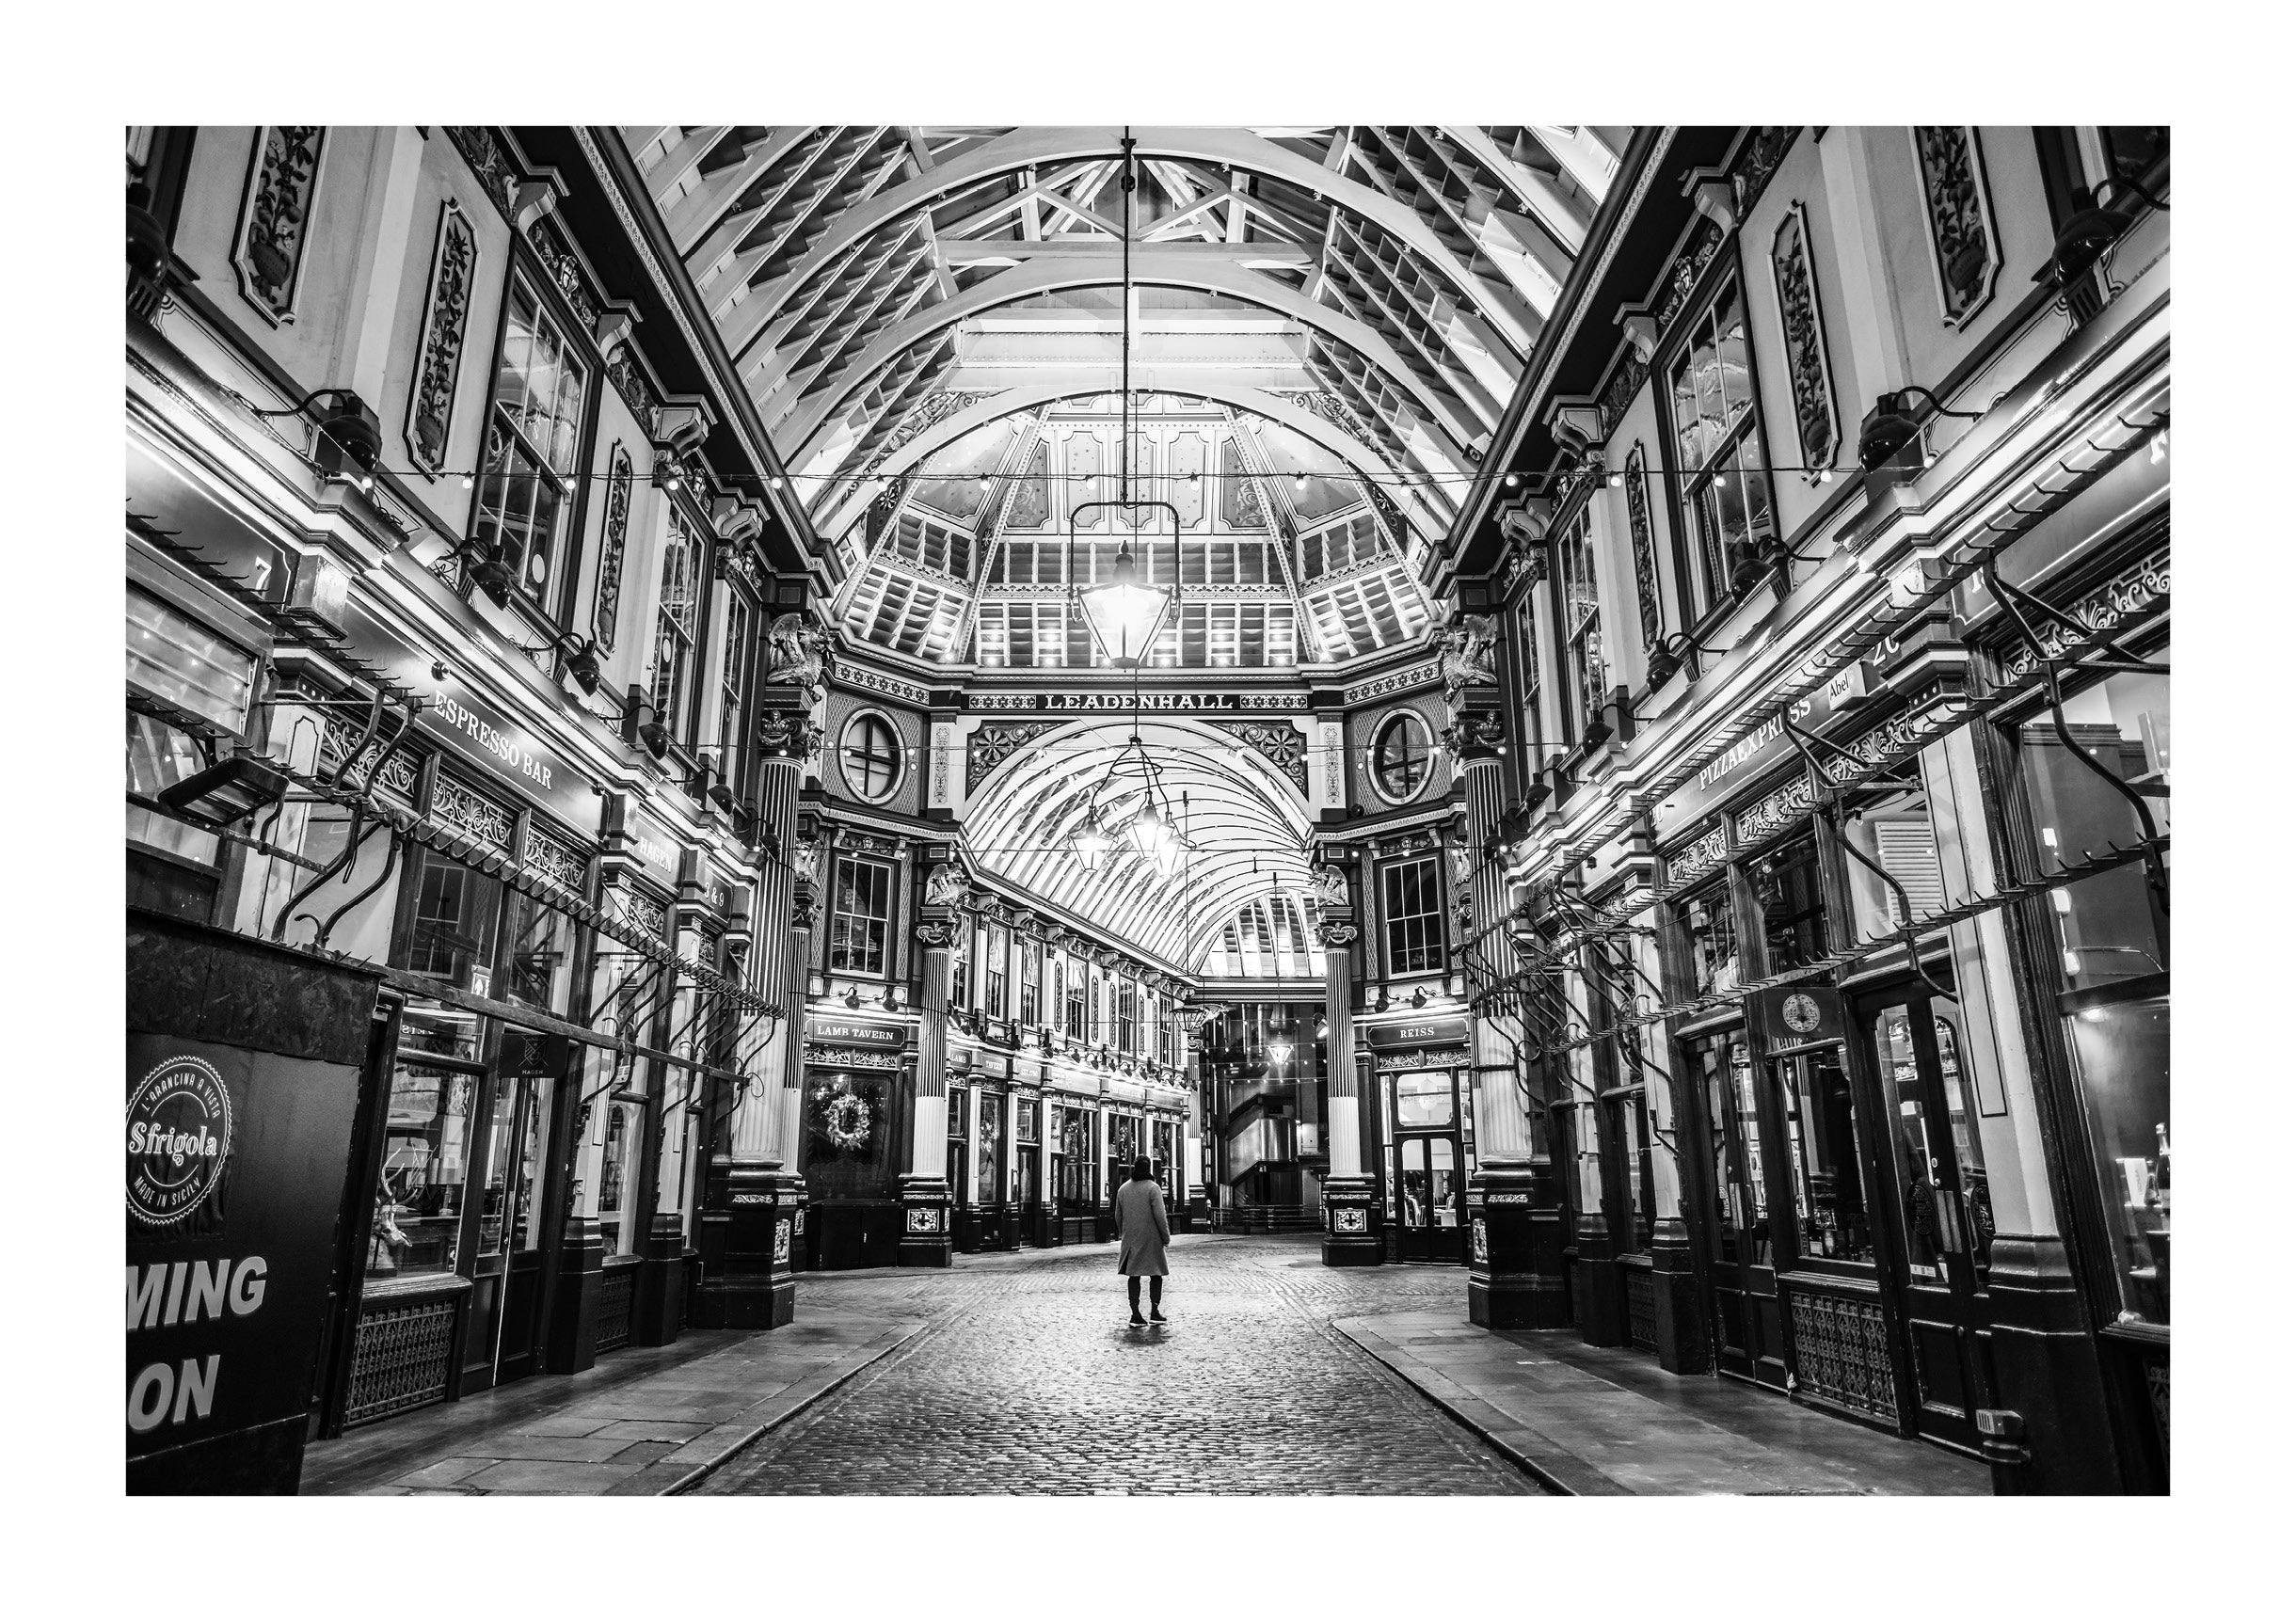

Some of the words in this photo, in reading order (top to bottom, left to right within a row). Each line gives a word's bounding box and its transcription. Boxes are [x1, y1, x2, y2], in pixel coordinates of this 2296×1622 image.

[1044, 694, 1234, 709] LEADENHALL
[1830, 672, 1849, 701] Abel
[433, 690, 519, 767] ESPRESSO
[522, 752, 551, 790] BAR
[640, 836, 672, 873] HAGEN
[719, 892, 725, 907] 9
[818, 1026, 849, 1036] LAMB
[852, 1028, 894, 1041] TAVERN
[1400, 1027, 1435, 1039] REISS
[141, 1073, 196, 1112] L'ARANCINA
[197, 1078, 205, 1090] A
[203, 1086, 221, 1119] VISTA
[128, 1121, 217, 1167] Sfrigola
[134, 1176, 156, 1204] MADE
[156, 1195, 167, 1208] IN
[171, 1176, 200, 1206] SICILY
[128, 1355, 220, 1431] ON
